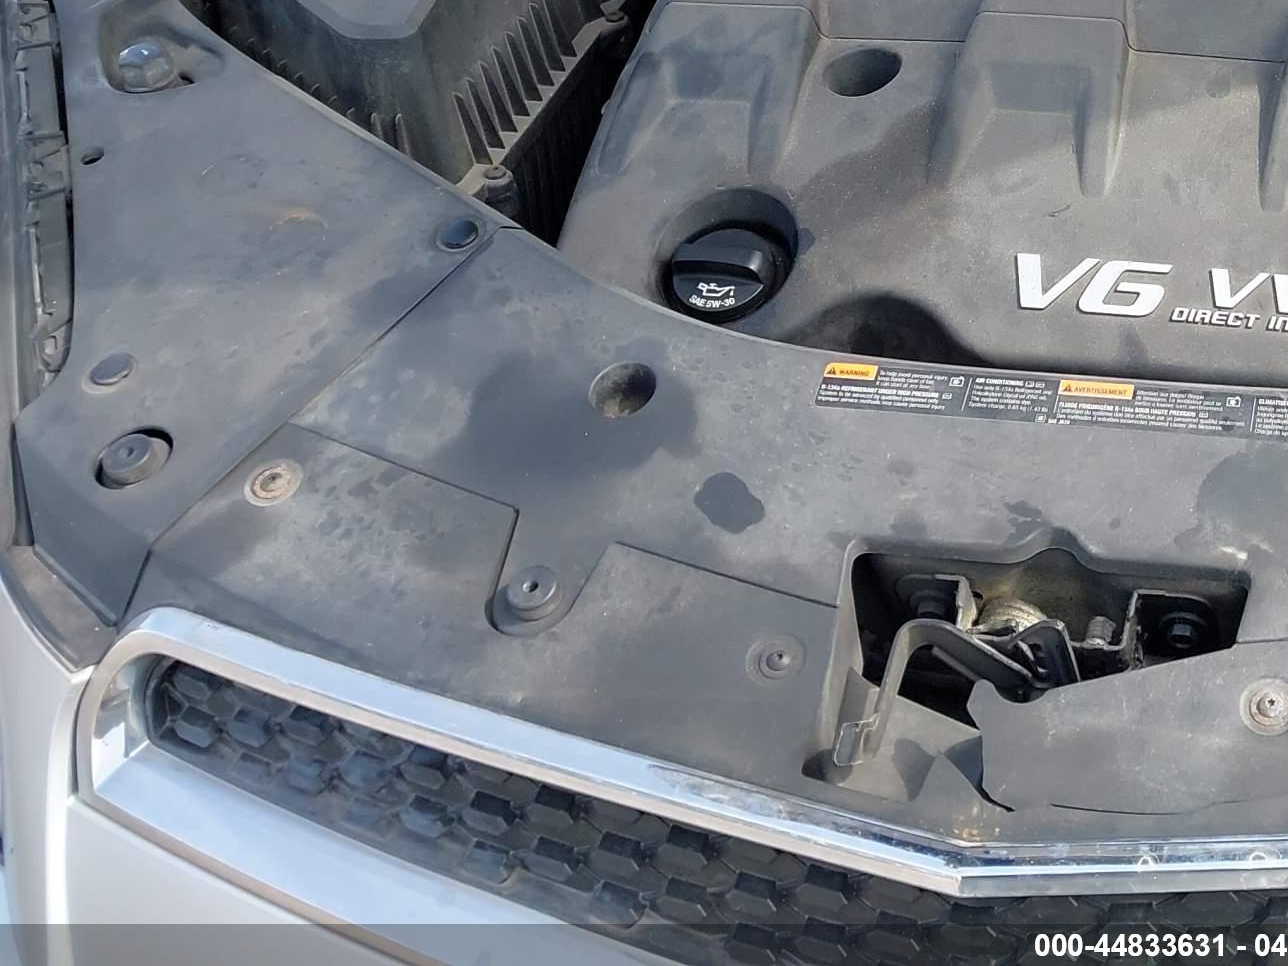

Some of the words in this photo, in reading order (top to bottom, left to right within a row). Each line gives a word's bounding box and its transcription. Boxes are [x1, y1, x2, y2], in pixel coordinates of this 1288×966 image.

[1016, 253, 1173, 317] V6
[688, 295, 707, 307] SAE
[706, 297, 735, 308] 5W-30
[1170, 307, 1261, 330] DIRECT
[1074, 386, 1127, 395] AVERTISSEMENT
